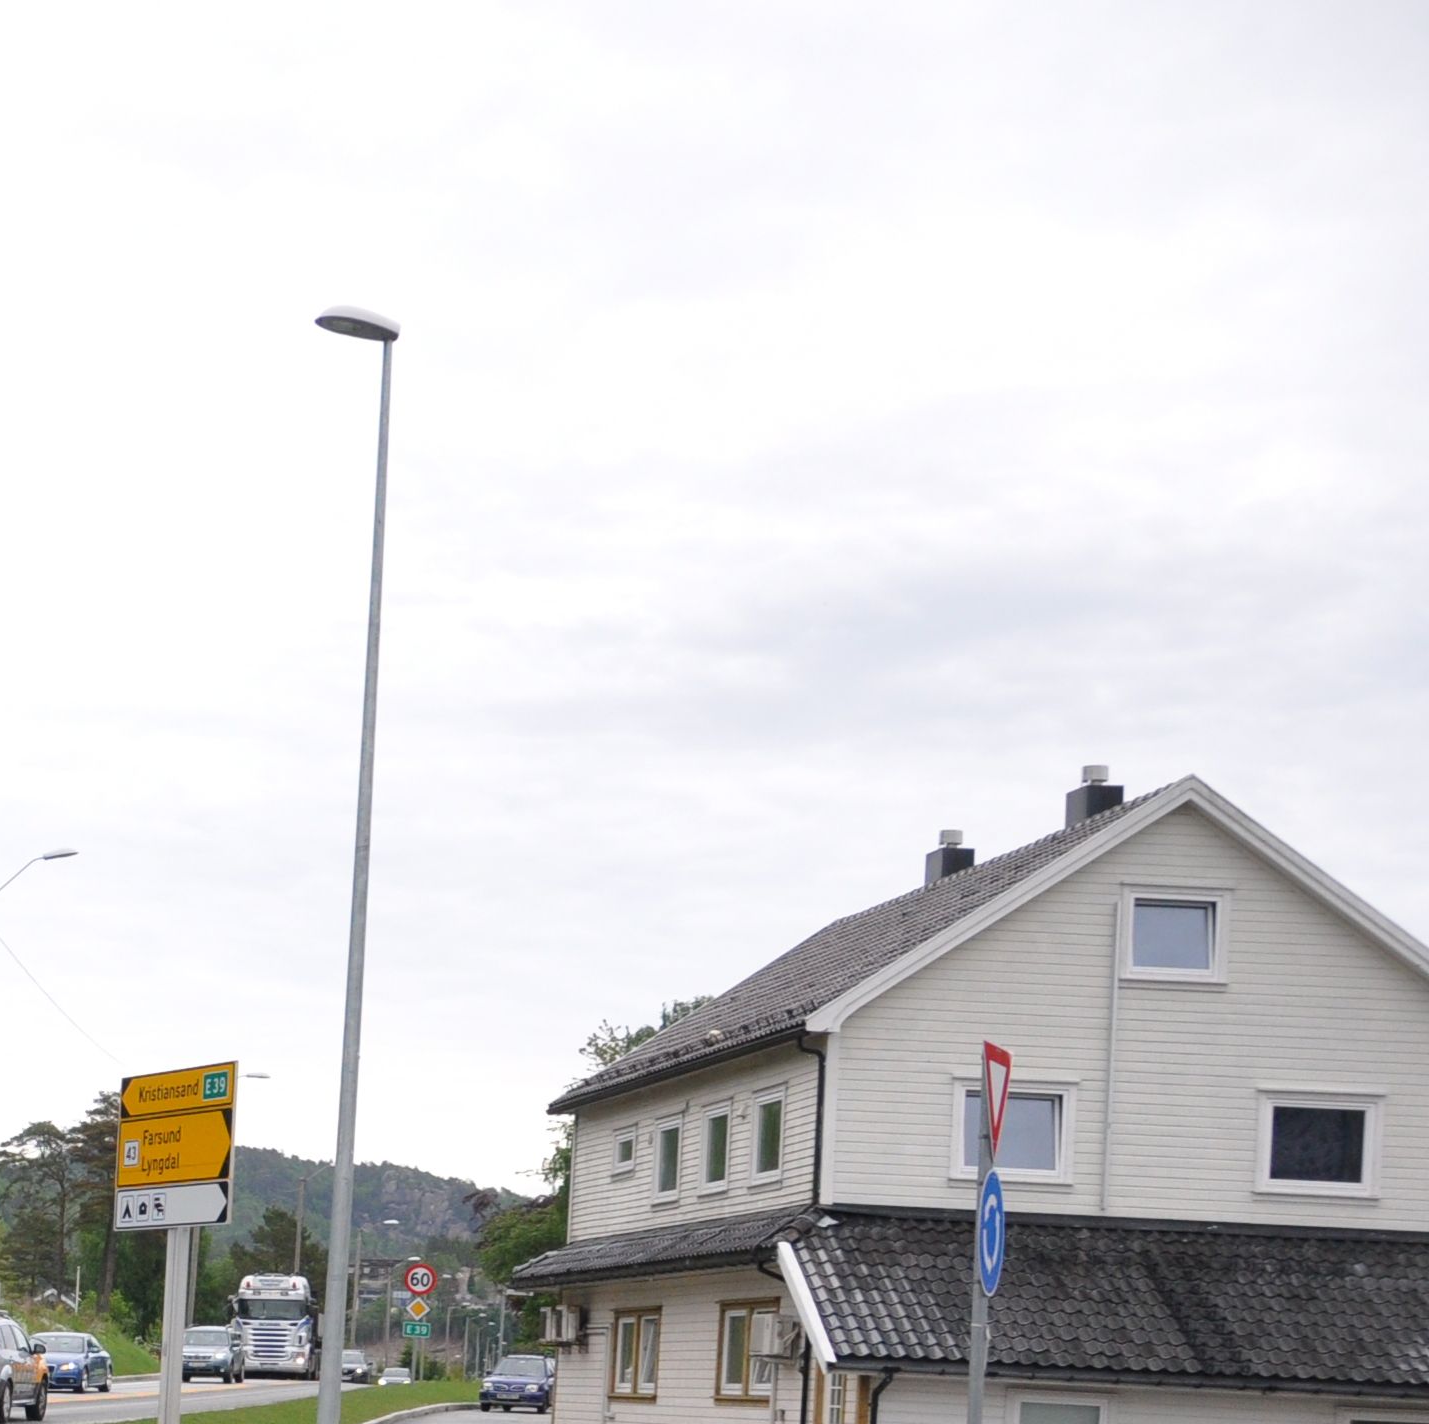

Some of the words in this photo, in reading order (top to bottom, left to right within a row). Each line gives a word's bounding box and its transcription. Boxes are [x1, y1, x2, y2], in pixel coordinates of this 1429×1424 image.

[139, 1080, 199, 1103] Kristiansand
[143, 1126, 181, 1146] Farsund
[126, 1146, 137, 1160] 43
[142, 1152, 180, 1176] Lyngdal
[410, 1272, 430, 1287] 60
